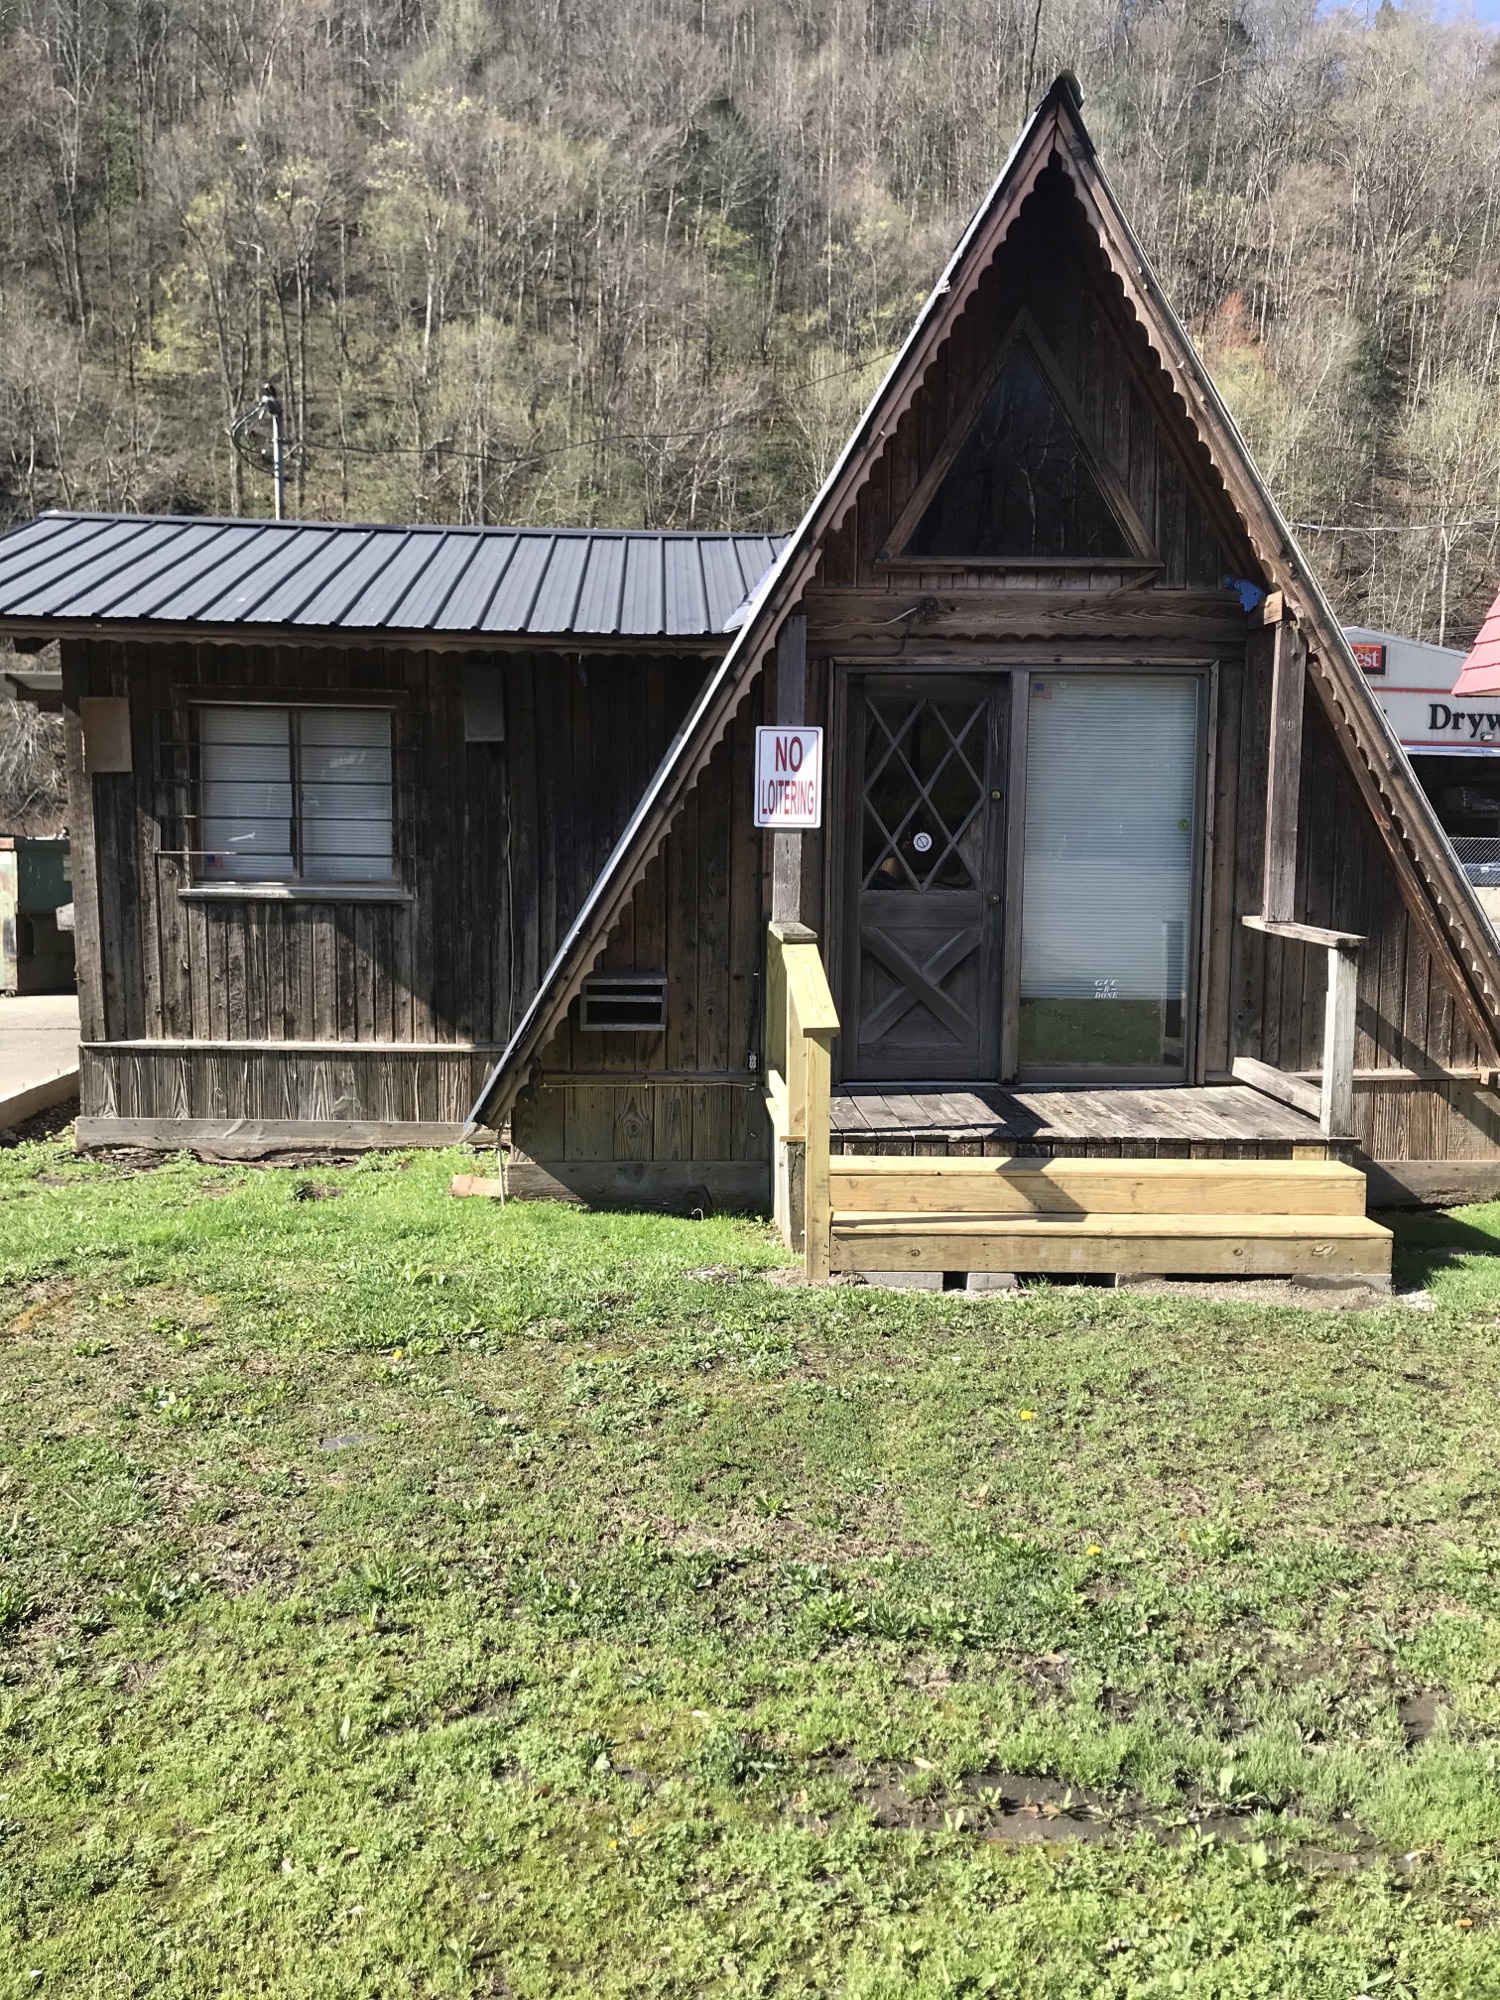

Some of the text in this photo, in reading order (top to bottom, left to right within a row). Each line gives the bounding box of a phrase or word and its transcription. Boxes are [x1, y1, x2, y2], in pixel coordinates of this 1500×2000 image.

[775, 736, 803, 772] NO
[762, 779, 814, 815] LOITERING
[1094, 991, 1119, 999] DONE
